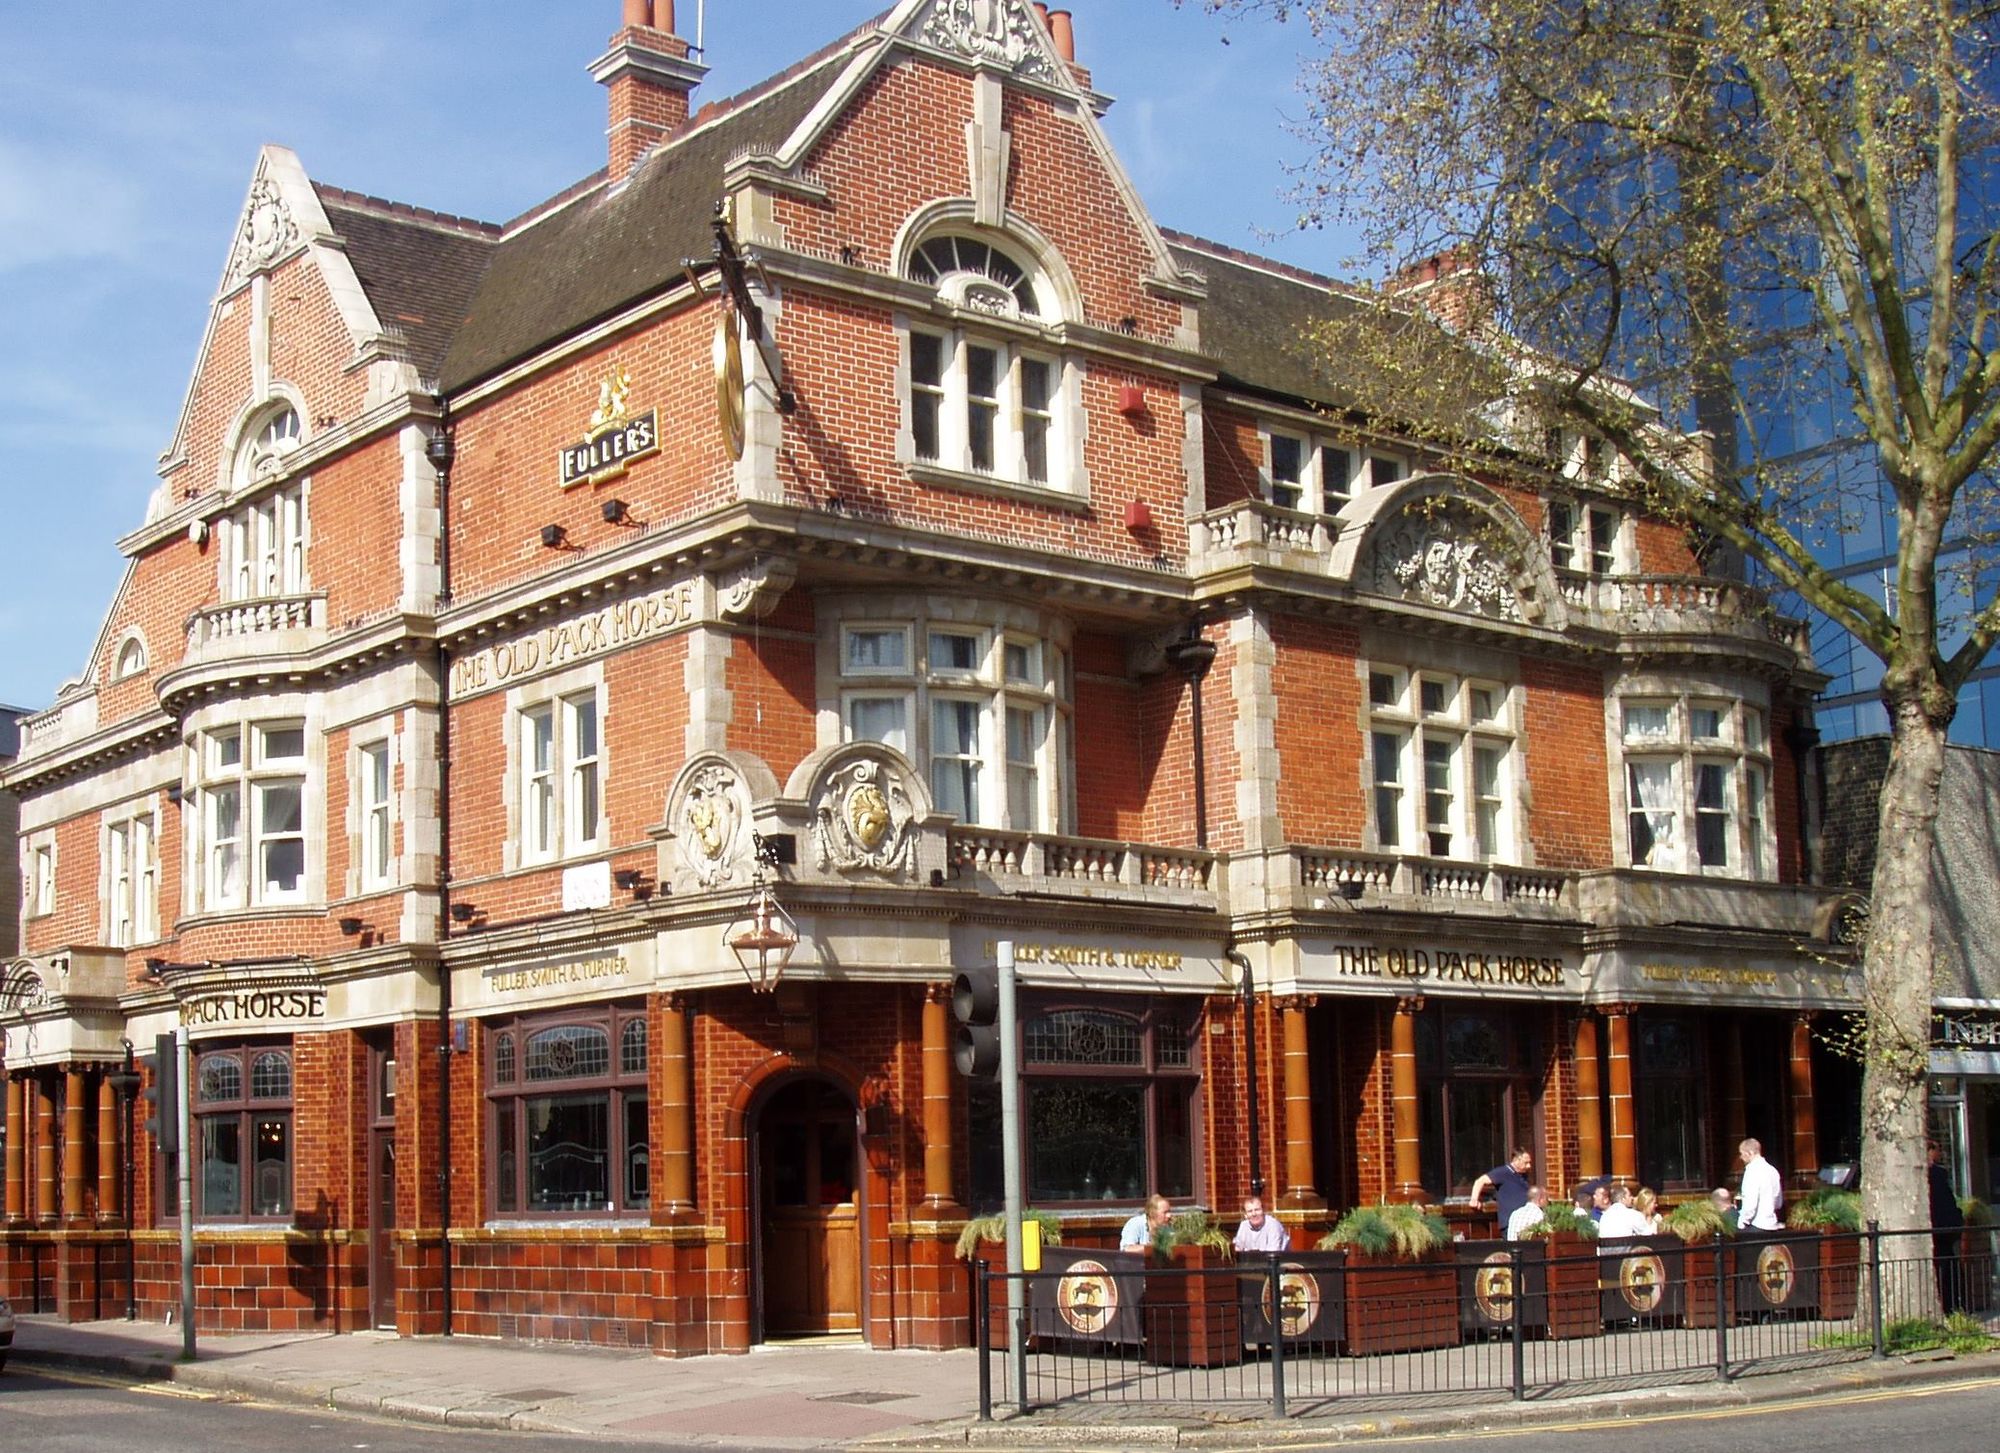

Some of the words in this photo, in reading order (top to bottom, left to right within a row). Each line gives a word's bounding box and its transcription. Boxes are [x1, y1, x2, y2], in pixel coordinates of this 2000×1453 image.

[564, 421, 654, 478] FULLER'S
[452, 656, 487, 694] THE
[545, 613, 607, 665] PACK
[492, 973, 529, 993] FULLER
[531, 965, 567, 988] SMITH
[571, 962, 581, 982] &
[582, 956, 630, 980] TURNER
[1049, 944, 1100, 967] SMITH
[1106, 948, 1117, 968] &
[1121, 948, 1182, 971] TURNER
[1333, 946, 1381, 976] THE
[1387, 948, 1429, 979] OLD
[1435, 951, 1493, 983] PACK
[1498, 955, 1565, 986] HORSE
[187, 996, 229, 1026] PACK
[234, 992, 325, 1019] HORSE
